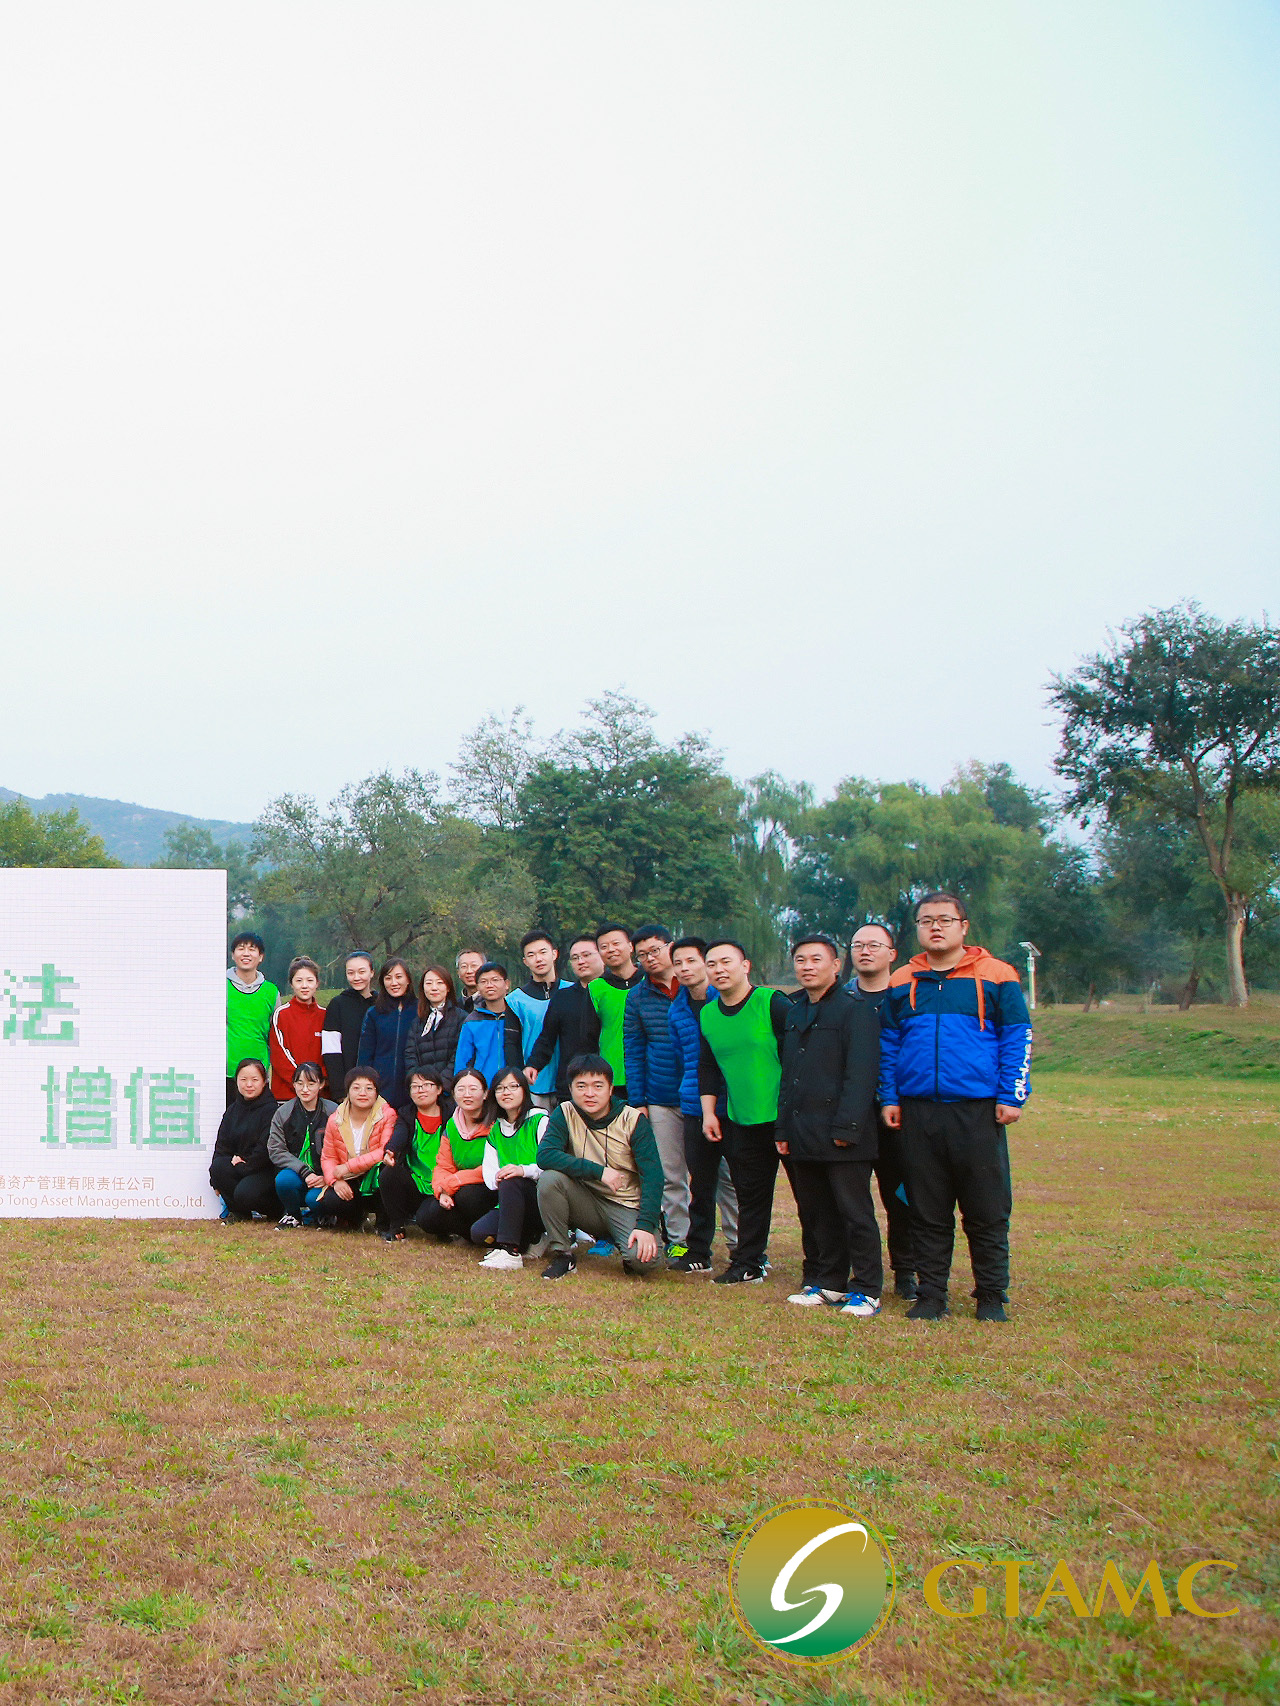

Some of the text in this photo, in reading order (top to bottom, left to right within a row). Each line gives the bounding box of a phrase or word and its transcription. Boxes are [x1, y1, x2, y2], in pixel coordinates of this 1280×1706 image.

[40, 1065, 207, 1151] 增值
[7, 1194, 38, 1208] Tong
[41, 1194, 74, 1207] Asset
[77, 1195, 160, 1209] Management
